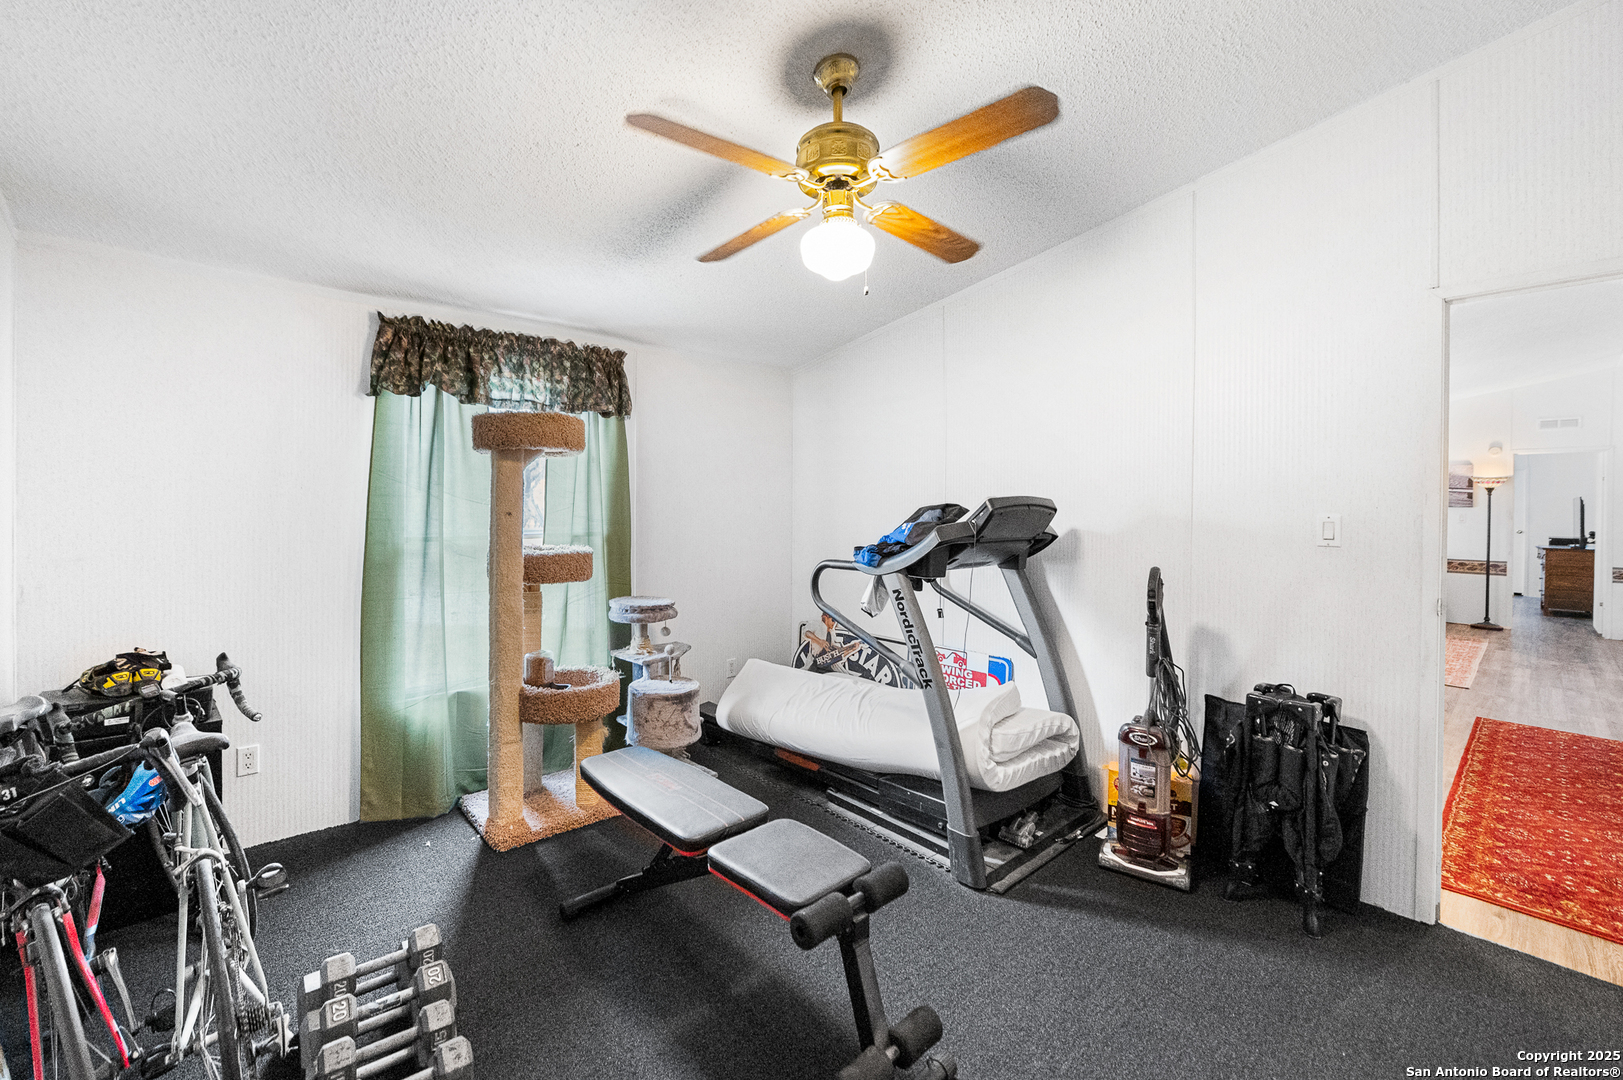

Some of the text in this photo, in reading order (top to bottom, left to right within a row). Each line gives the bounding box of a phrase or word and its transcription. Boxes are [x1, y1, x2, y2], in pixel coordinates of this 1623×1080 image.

[892, 588, 932, 690] NordicTrack
[428, 966, 442, 986] 20
[333, 1001, 347, 1022] 20
